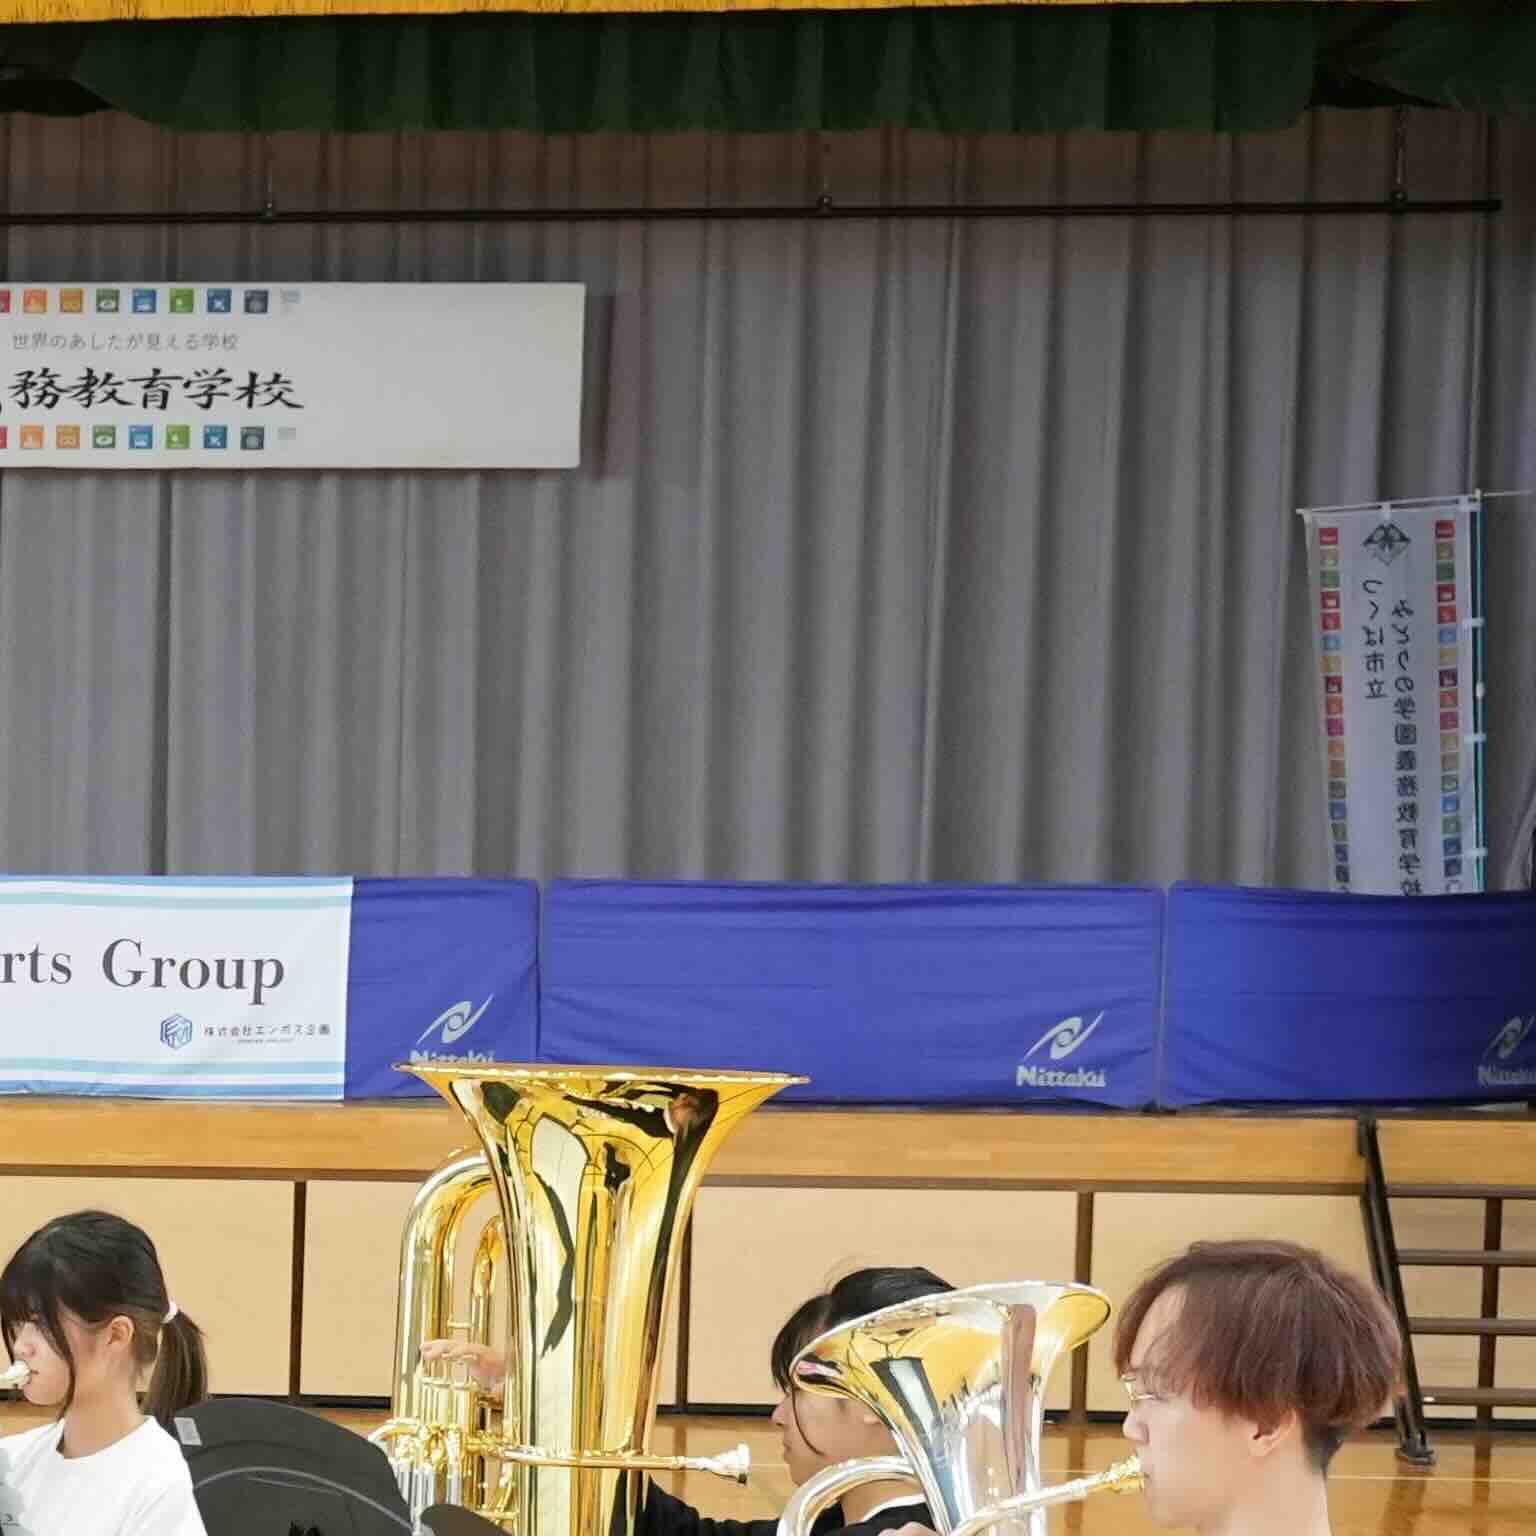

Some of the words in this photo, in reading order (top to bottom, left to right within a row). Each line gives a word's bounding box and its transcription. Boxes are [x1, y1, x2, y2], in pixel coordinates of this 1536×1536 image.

[12, 331, 241, 351] 世界のあしたが見える学校
[101, 937, 287, 1005] Group
[1016, 1065, 1106, 1088] Nittaku
